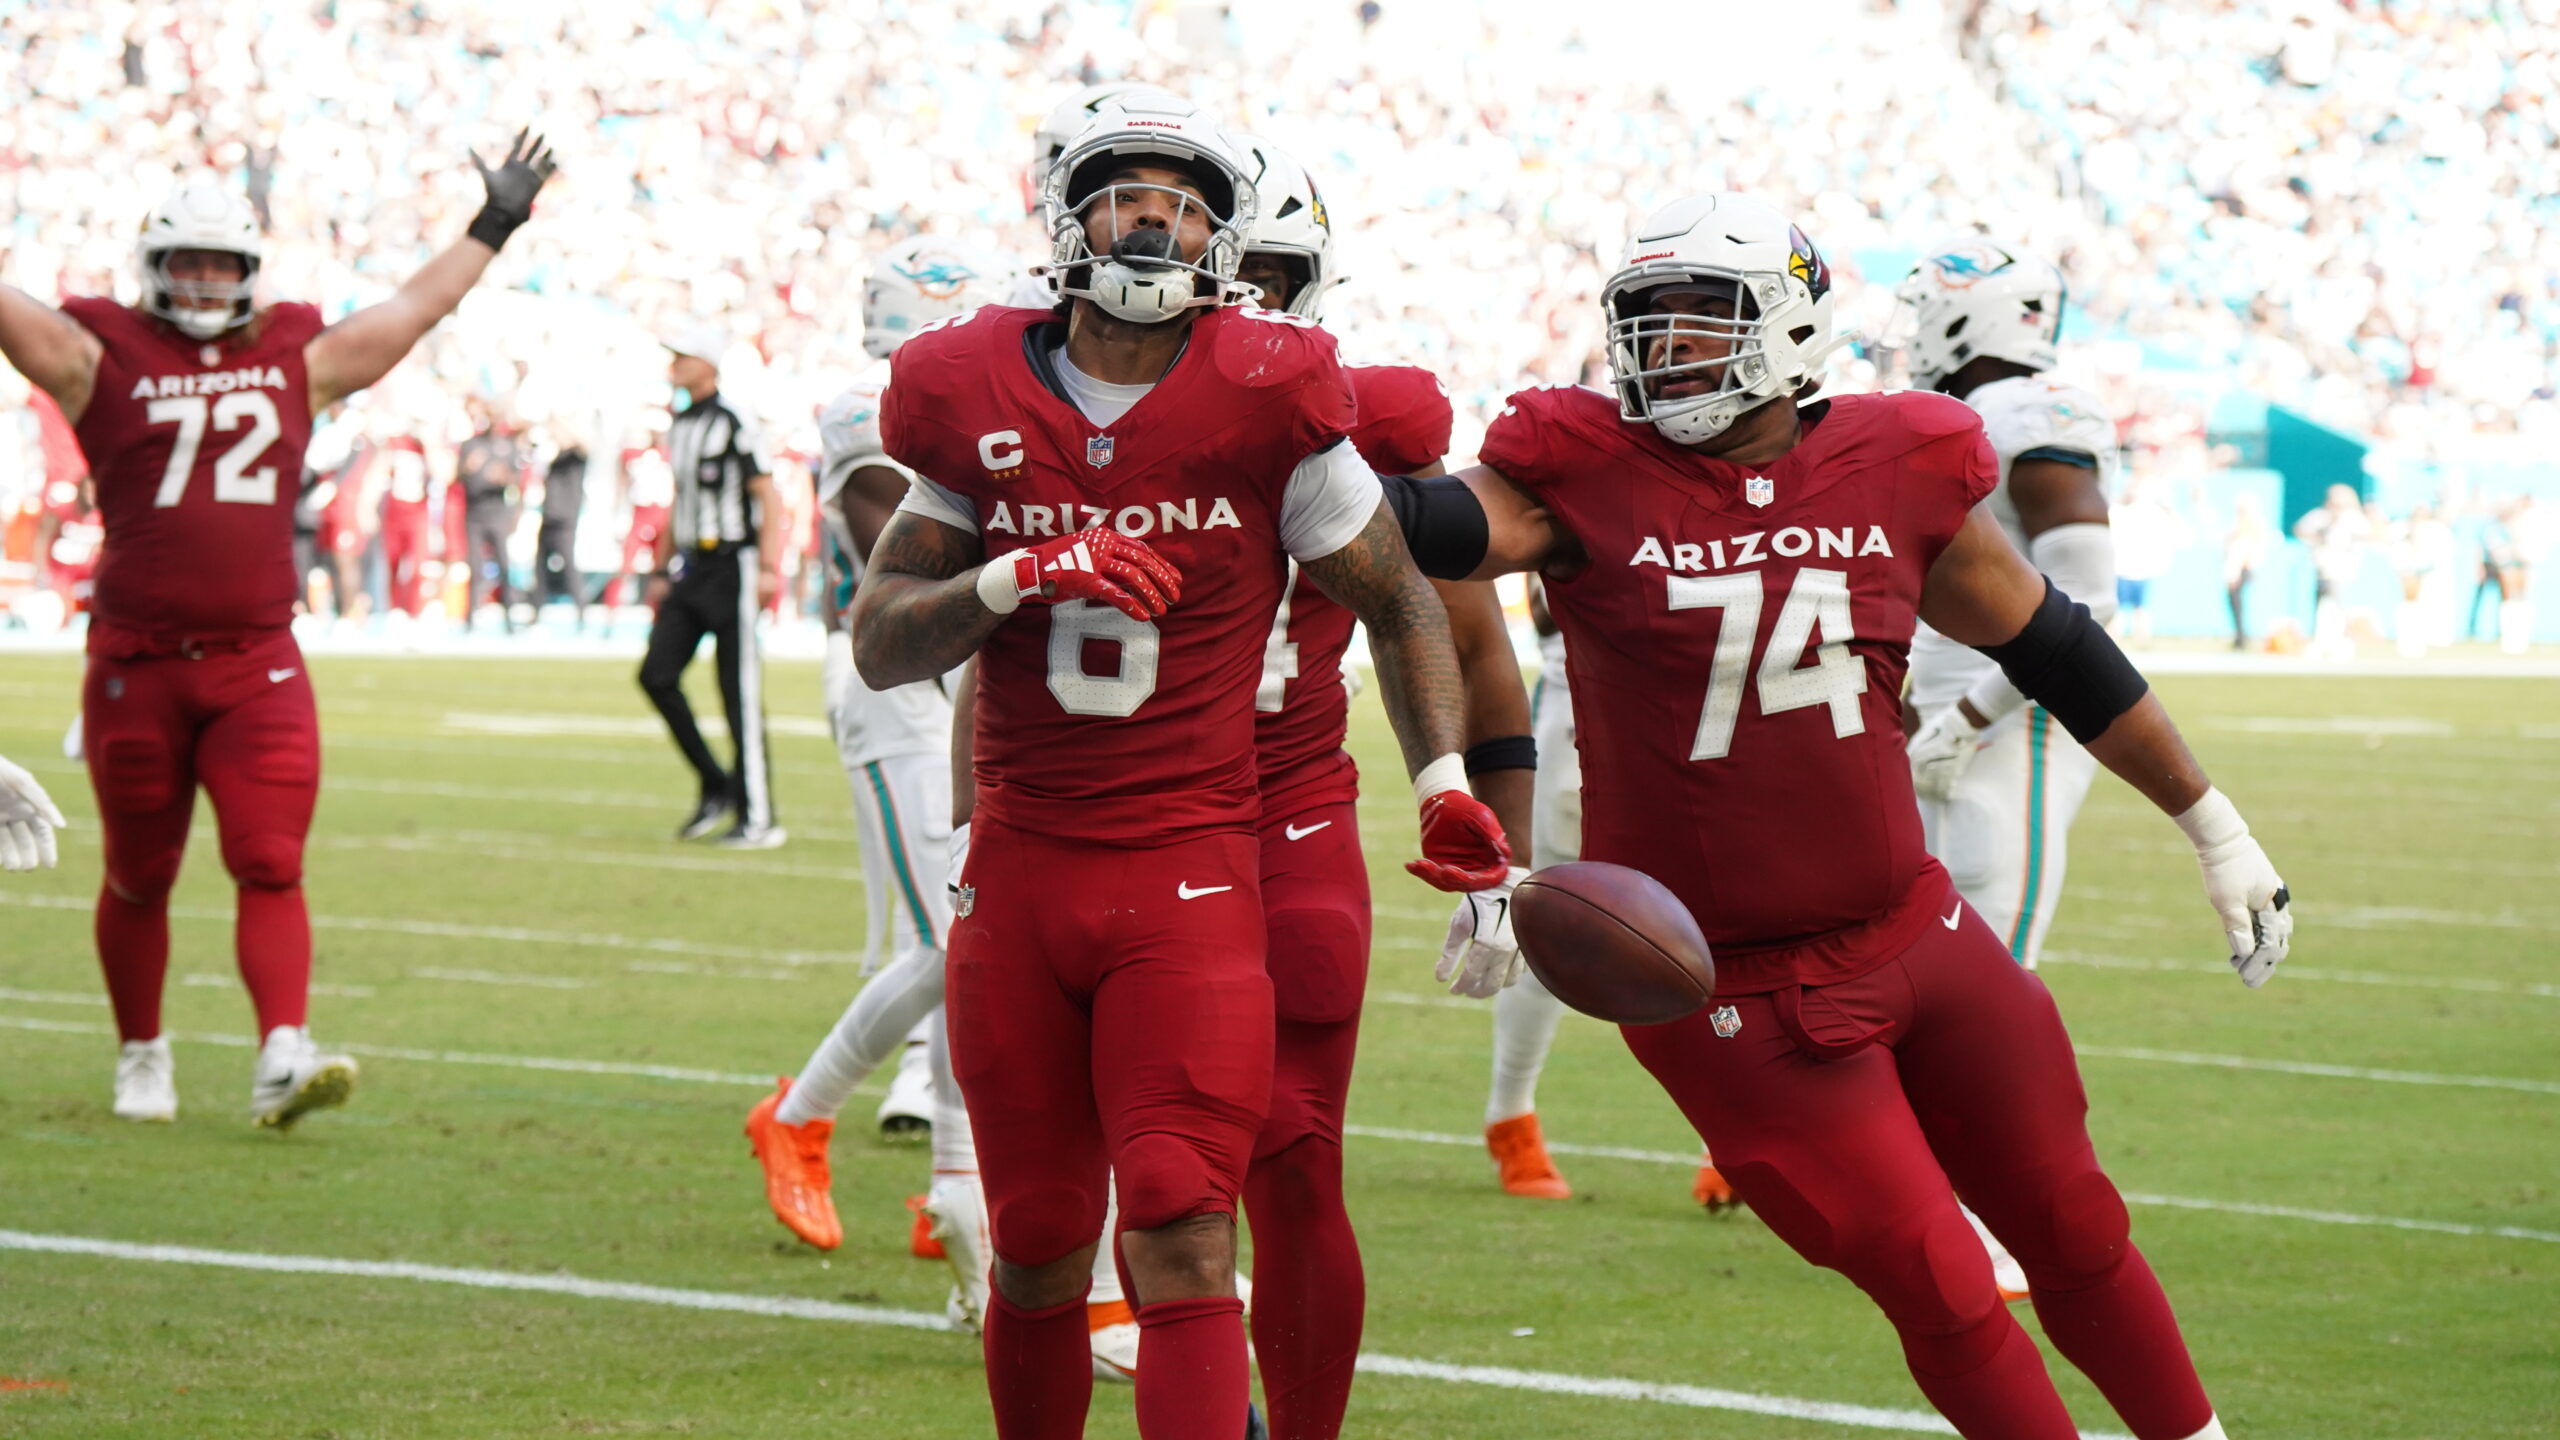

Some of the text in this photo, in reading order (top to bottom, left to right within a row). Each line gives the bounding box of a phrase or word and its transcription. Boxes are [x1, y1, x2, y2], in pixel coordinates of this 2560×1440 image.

[131, 366, 288, 399] ARIZONA
[146, 390, 282, 508] 72
[977, 429, 1024, 471] C
[986, 497, 1242, 537] ARIZONA
[1628, 525, 1894, 572] ARIZONA
[1046, 598, 1160, 717] 6
[1666, 567, 1868, 761] 74
